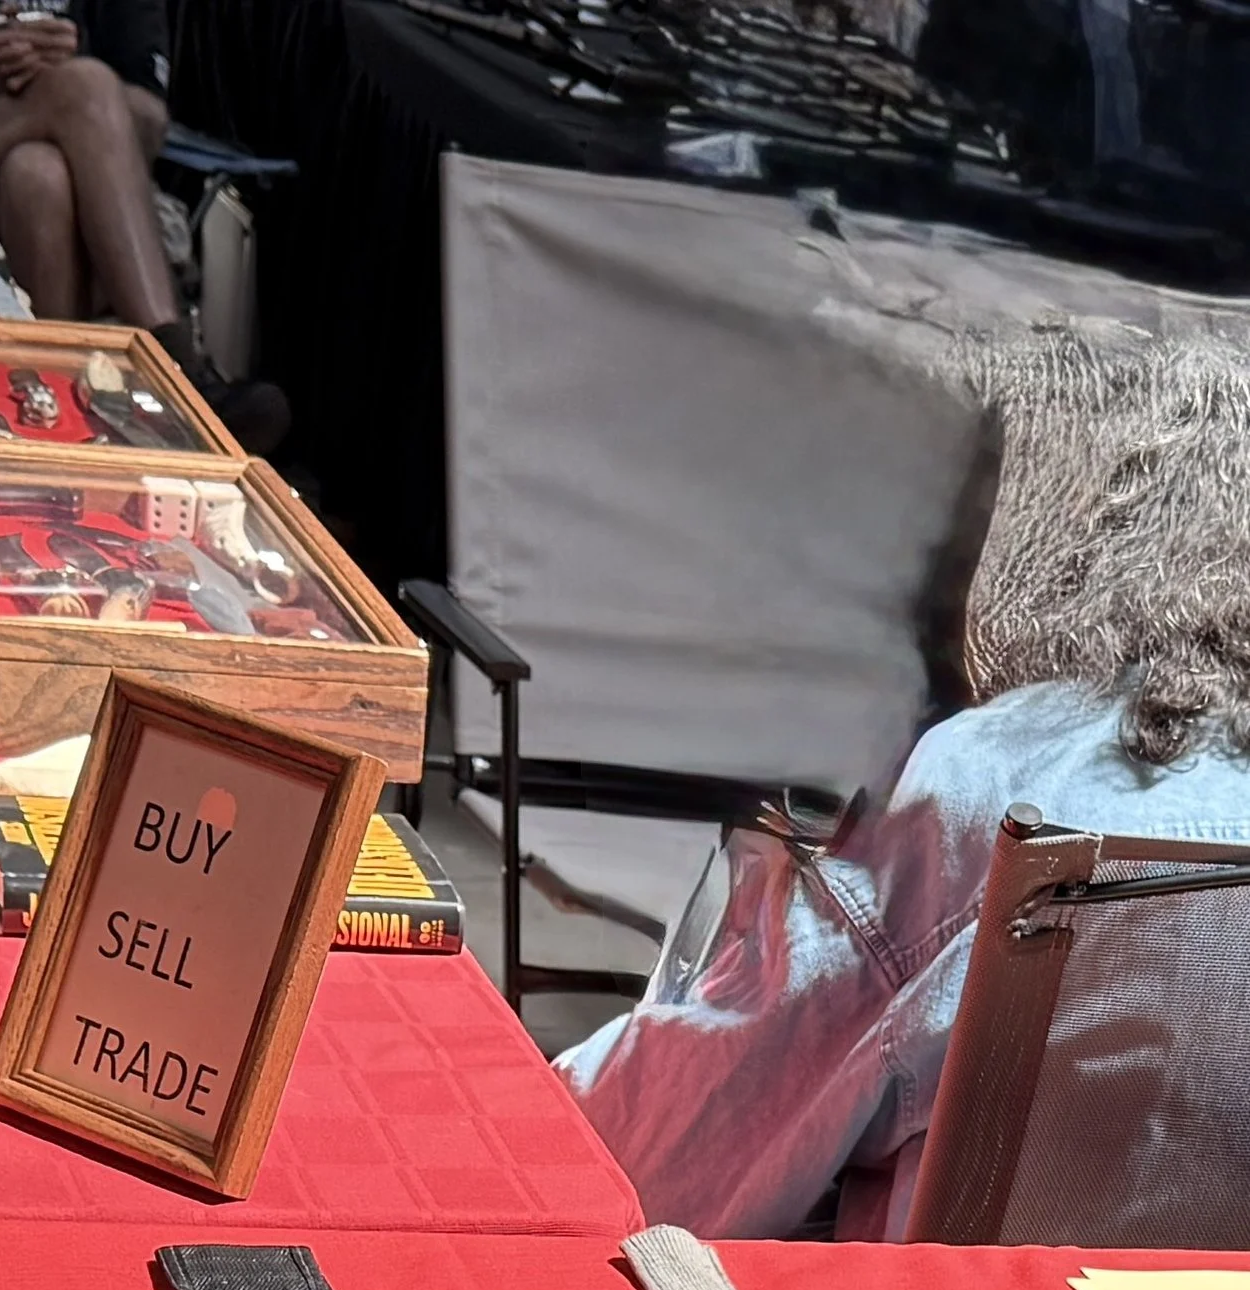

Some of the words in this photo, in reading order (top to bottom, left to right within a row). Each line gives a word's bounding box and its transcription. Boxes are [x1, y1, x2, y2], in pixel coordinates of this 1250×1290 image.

[133, 801, 232, 875] BUY
[98, 910, 194, 990] SELL
[331, 910, 412, 949] SIONAL
[72, 1015, 219, 1116] TRADE
